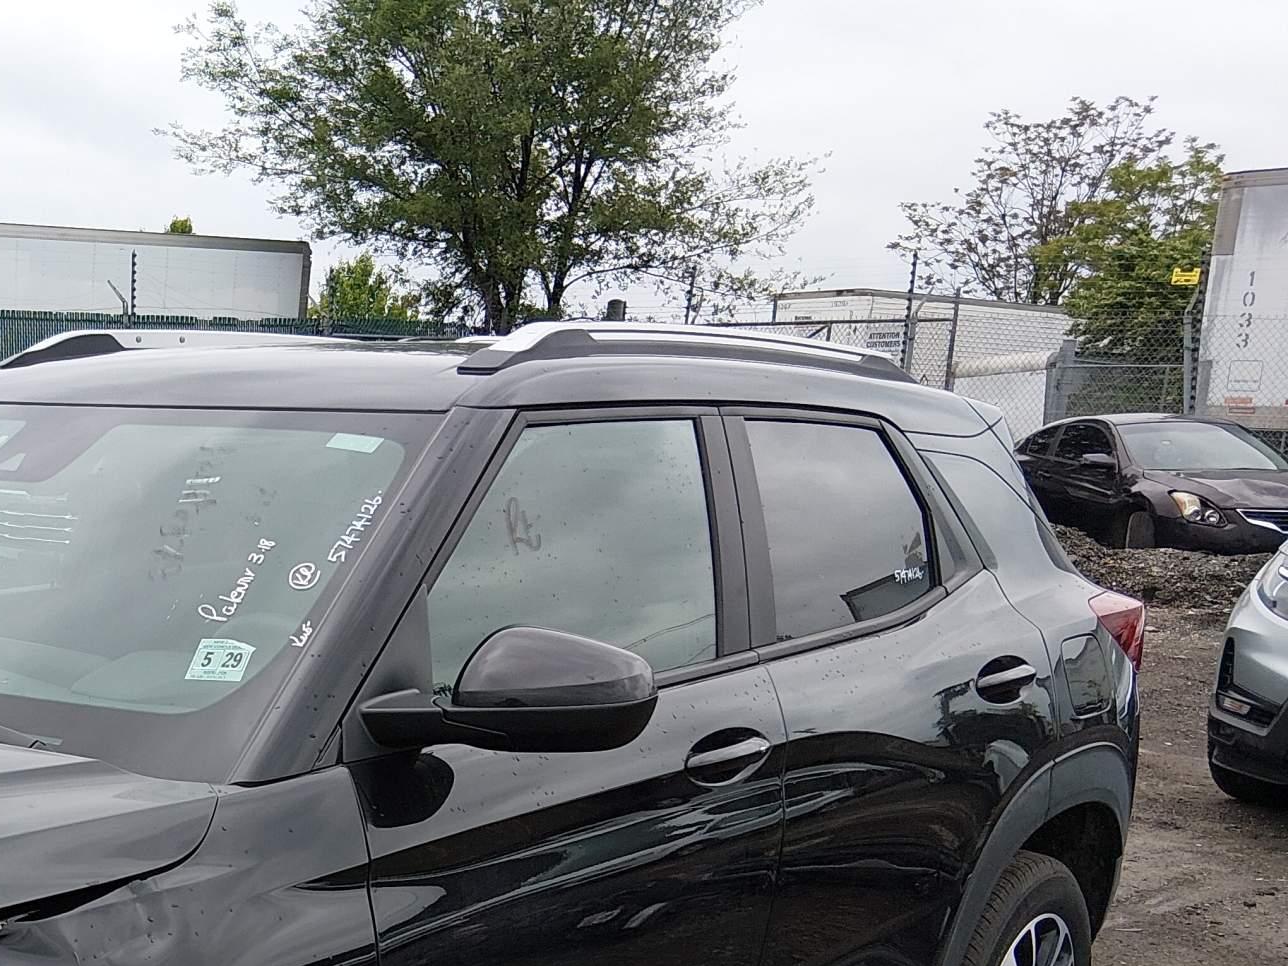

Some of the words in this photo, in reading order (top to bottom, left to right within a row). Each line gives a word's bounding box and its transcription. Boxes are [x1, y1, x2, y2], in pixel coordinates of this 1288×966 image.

[1236, 271, 1256, 348] 1033
[868, 332, 900, 340] ATTENTION
[866, 340, 901, 349] CUSTOMERS
[200, 651, 215, 668] 5
[220, 651, 244, 669] 29
